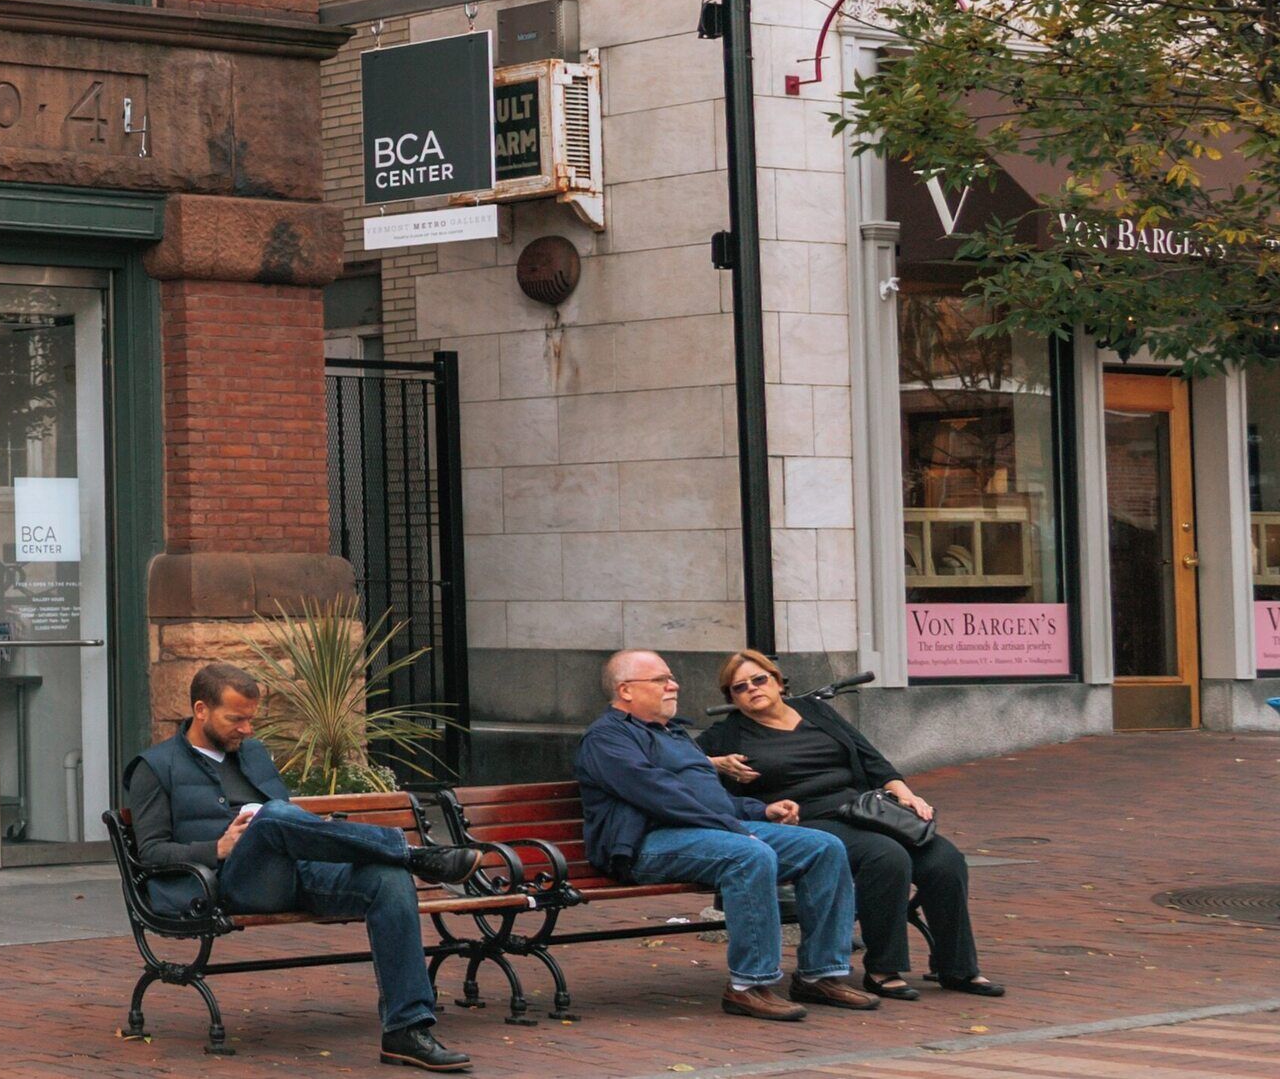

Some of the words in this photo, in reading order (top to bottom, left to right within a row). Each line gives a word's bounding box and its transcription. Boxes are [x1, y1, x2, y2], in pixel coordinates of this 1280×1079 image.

[65, 80, 109, 144] 4
[494, 93, 534, 124] ULT
[374, 129, 445, 169] BCA
[375, 163, 454, 189] CENTER
[413, 220, 447, 231] METRO
[450, 215, 493, 226] GALLERY
[21, 525, 57, 543] BCA
[22, 544, 62, 554] CENTER
[911, 610, 955, 636] VON
[963, 612, 1057, 636] BARGEN'S
[918, 641, 933, 652] The
[934, 640, 955, 652] finest
[956, 640, 991, 651] diamonds
[992, 641, 1000, 651] &
[1001, 641, 1025, 651] artisan
[1026, 640, 1052, 654] jewelry
